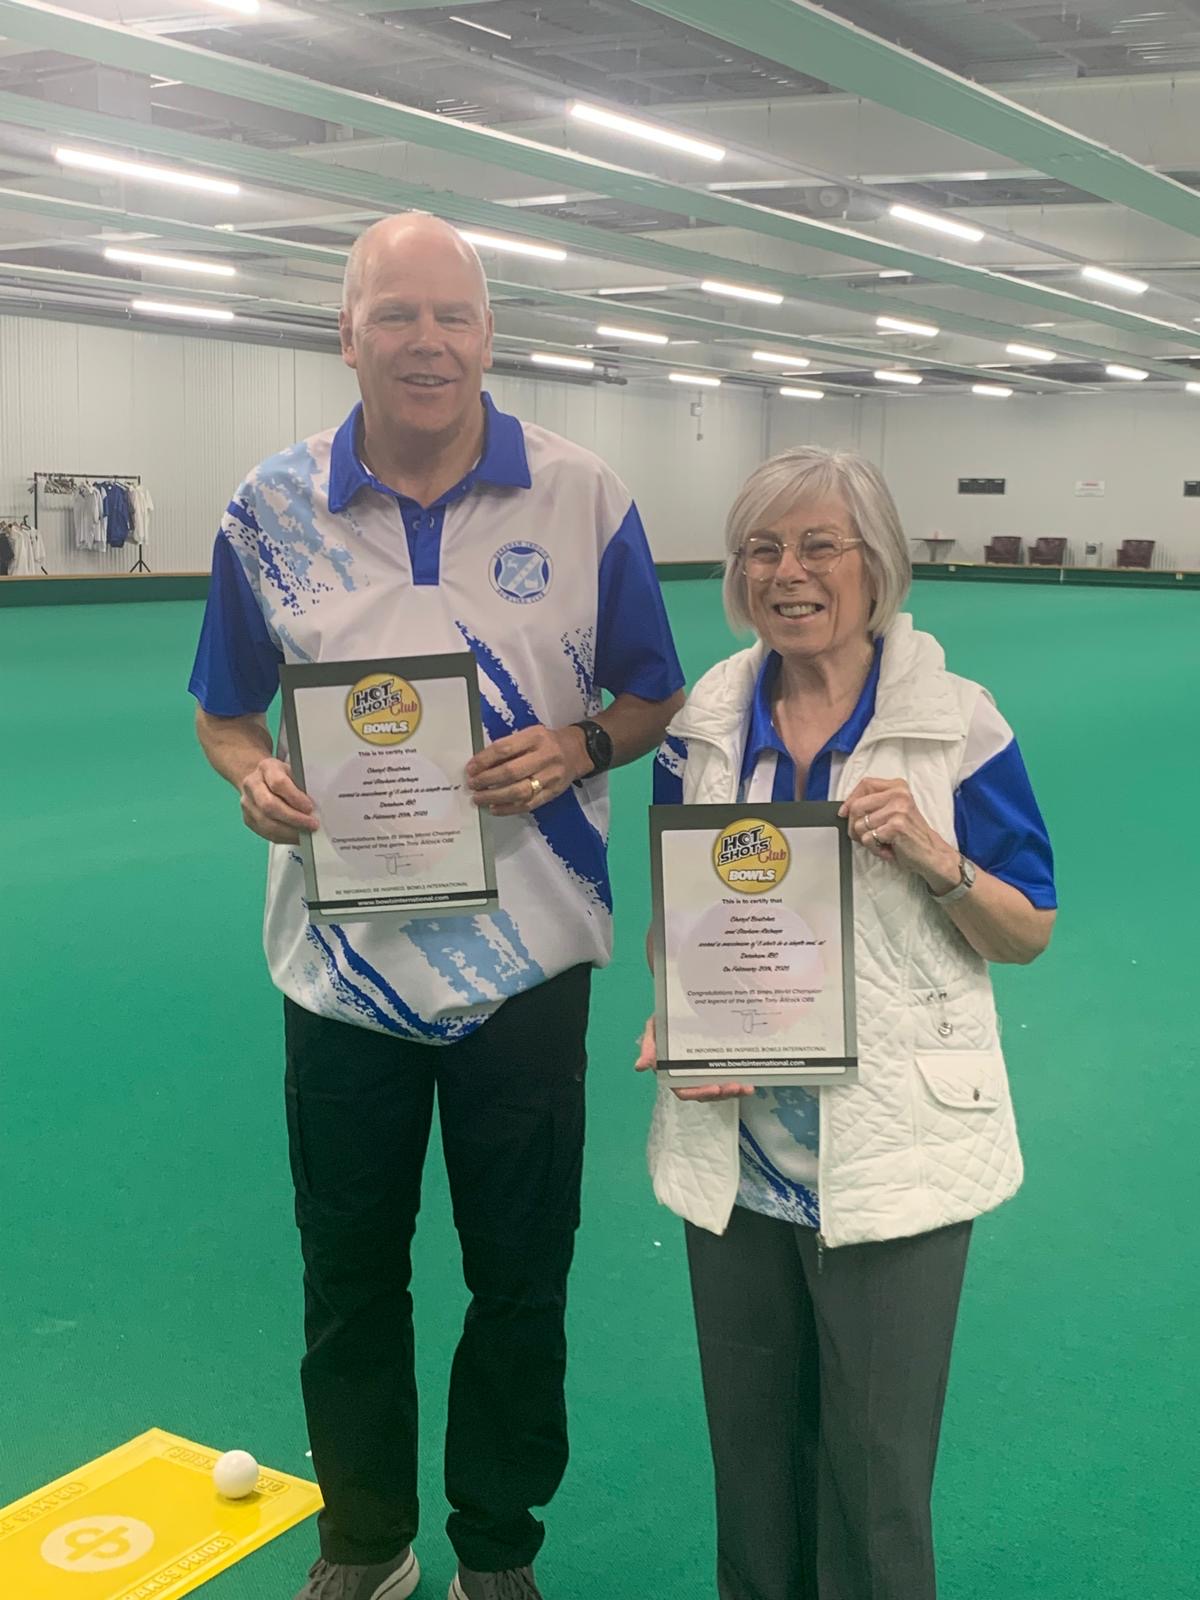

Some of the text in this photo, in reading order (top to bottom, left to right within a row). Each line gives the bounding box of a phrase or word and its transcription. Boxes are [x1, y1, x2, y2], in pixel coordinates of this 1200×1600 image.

[352, 692, 418, 718] SHOTS Club
[355, 681, 394, 707] HOT
[362, 720, 409, 734] BOWLS
[719, 839, 787, 864] SHOTS Club
[722, 827, 764, 852] HOT
[728, 868, 776, 882] BOWLS
[178, 1538, 232, 1571] PRIDE
